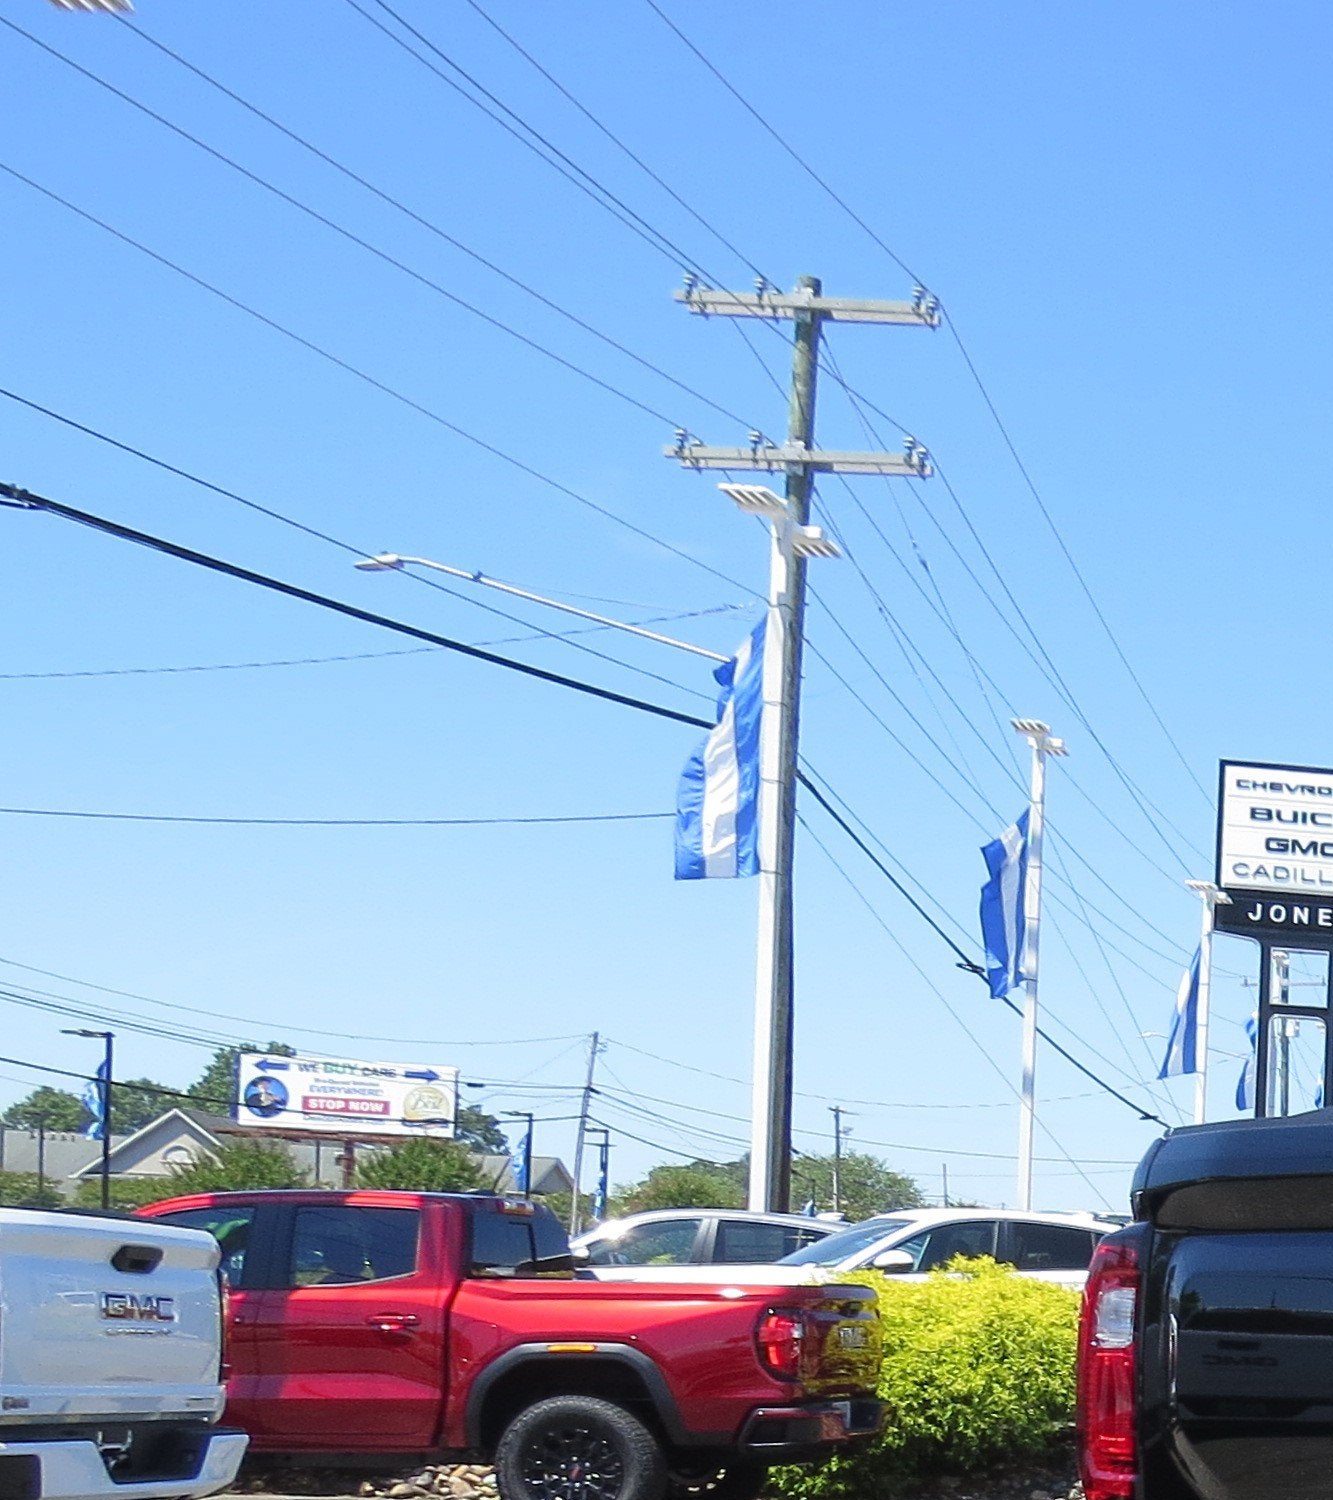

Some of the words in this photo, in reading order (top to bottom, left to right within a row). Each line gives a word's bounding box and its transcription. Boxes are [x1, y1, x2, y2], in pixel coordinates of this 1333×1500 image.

[308, 1098, 346, 1109] STOP
[348, 1101, 384, 1112] NOW
[101, 1291, 179, 1323] GMC
